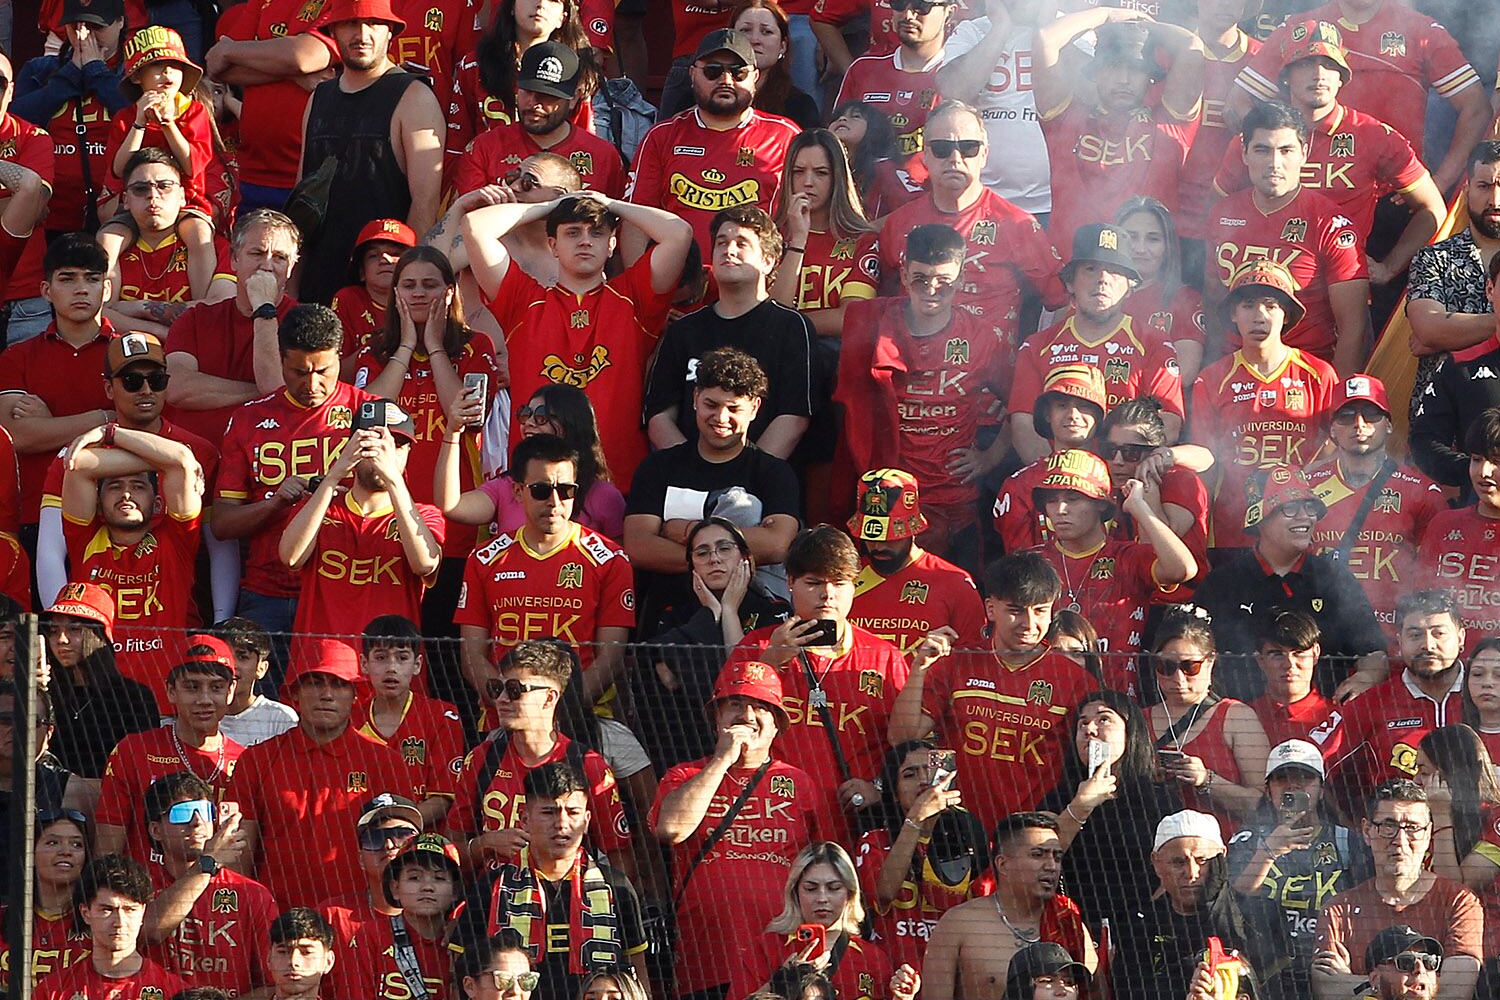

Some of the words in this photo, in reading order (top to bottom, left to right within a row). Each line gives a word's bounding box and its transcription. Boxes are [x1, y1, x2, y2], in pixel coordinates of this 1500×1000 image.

[988, 51, 1034, 92] SE
[1078, 133, 1152, 165] SEK
[1299, 163, 1356, 189] EK
[672, 180, 758, 208] CRISTAL
[798, 266, 854, 310] EK
[906, 370, 967, 397] EK
[897, 401, 958, 419] arken
[1237, 421, 1307, 434] UNIVERSIDAD
[1235, 435, 1306, 466] SEK
[318, 549, 403, 586] SEK
[1350, 547, 1400, 583] EK
[494, 596, 583, 610] UNIVERSIDAD
[497, 613, 583, 648] SEK
[849, 617, 930, 632] NIVERSIDAD
[966, 704, 1052, 731] UNIVERSIDAD
[963, 721, 1047, 767] SEK
[178, 918, 238, 948] EK
